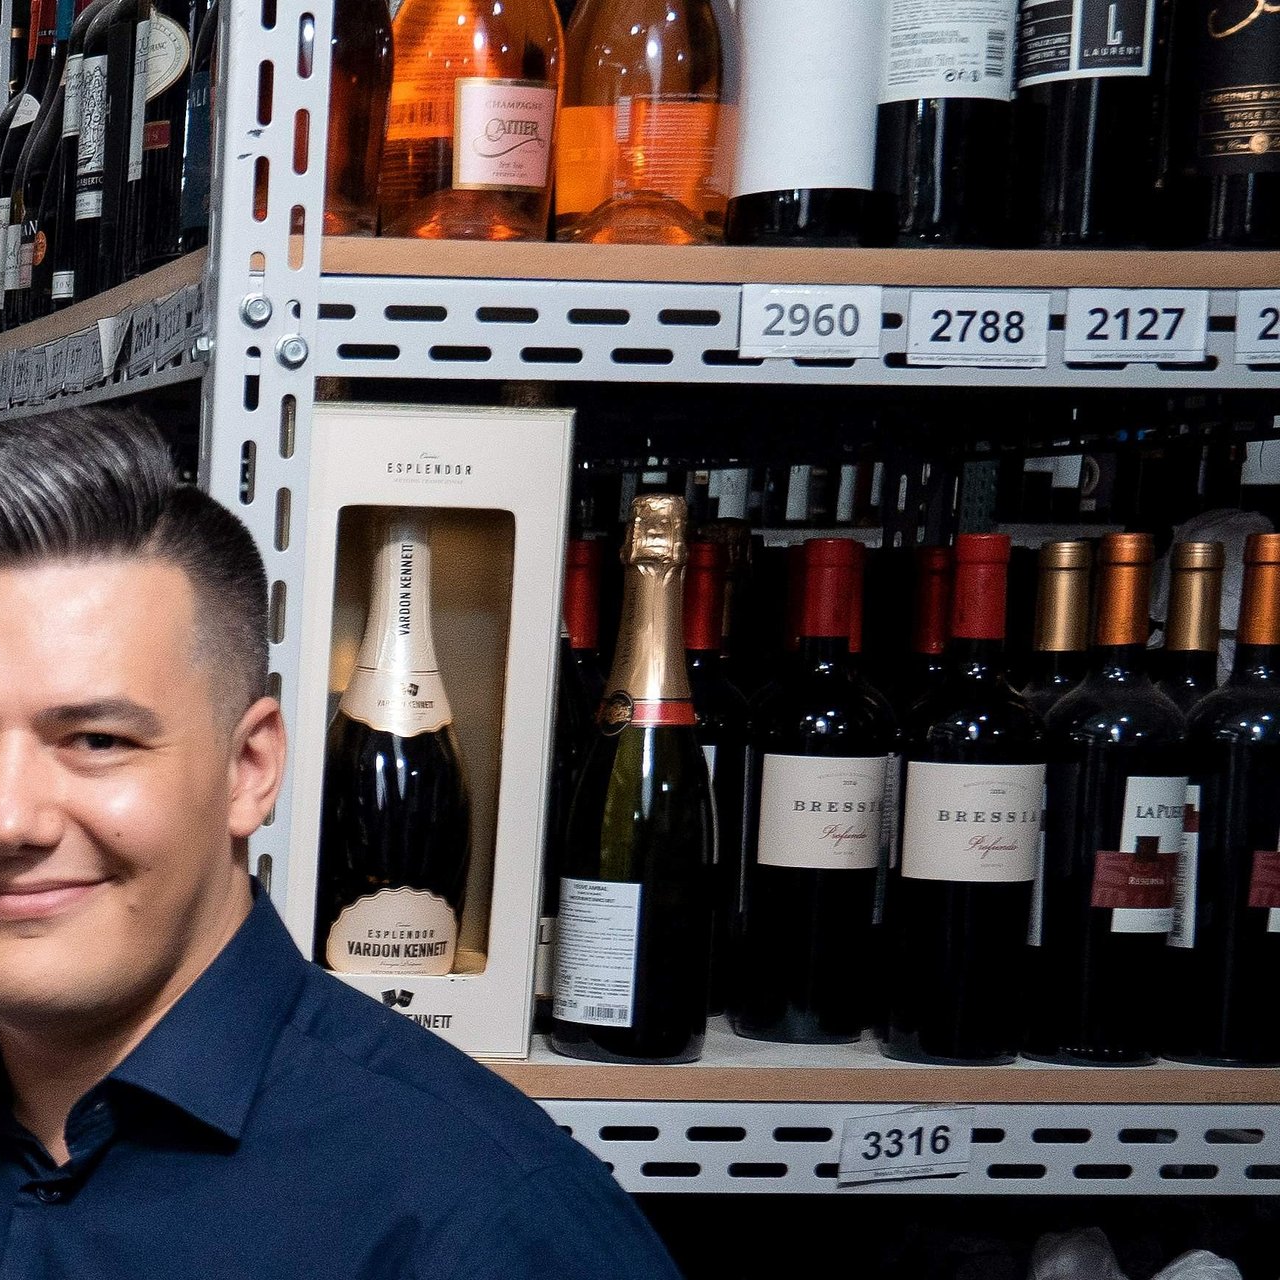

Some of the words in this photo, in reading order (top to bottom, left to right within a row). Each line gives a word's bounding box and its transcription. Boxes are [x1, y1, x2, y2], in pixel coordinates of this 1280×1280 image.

[762, 303, 860, 337] 2960
[929, 308, 1025, 342] 2788
[1085, 306, 1185, 341] 2127
[387, 462, 473, 475] ESPLENDOR
[400, 542, 414, 592] KENNETT
[398, 592, 411, 637] VARDON
[818, 824, 867, 847] Profundo
[963, 834, 1019, 860] Profundo
[347, 940, 400, 958] VARDON
[403, 940, 448, 958] KENNETT
[367, 929, 435, 939] ESPLENDOR
[861, 1124, 951, 1161] 3316
